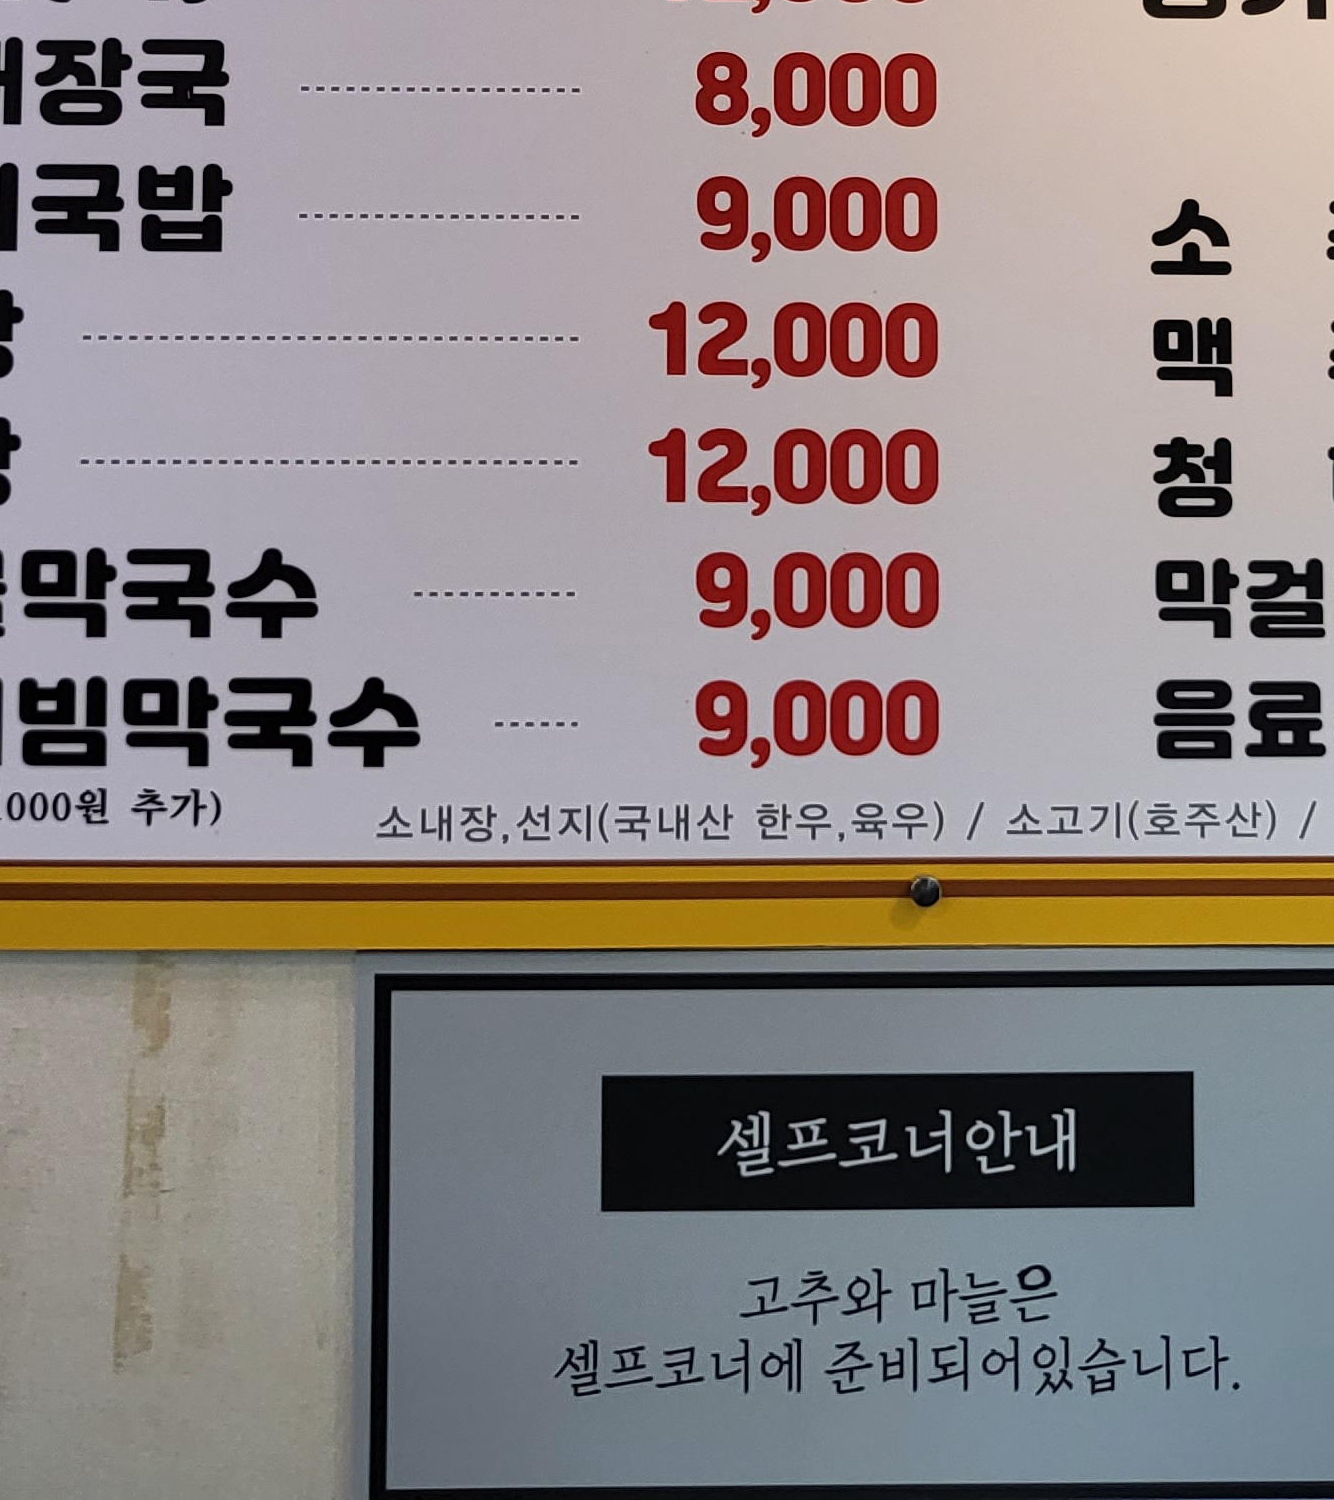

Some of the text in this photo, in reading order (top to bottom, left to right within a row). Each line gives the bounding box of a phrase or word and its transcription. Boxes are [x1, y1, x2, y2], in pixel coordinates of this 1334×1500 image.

[695, 51, 937, 138] 8,000
[696, 175, 938, 263] 9,000
[648, 301, 939, 389] 12,000
[648, 427, 939, 517] 12,000
[695, 551, 940, 641] 9,000
[695, 679, 940, 769] 9,000
[130, 788, 222, 827] 추가)
[376, 802, 734, 845] 소내장,선지(국내산
[756, 800, 944, 843] 한우,육우)
[1006, 799, 1276, 841] 소고기(호주산)
[717, 1107, 1076, 1177] 셀프코너안내
[739, 1264, 1058, 1327] 고추와 마늘은
[554, 1334, 1240, 1397] 셀프코너에 준비되어있습니다.
